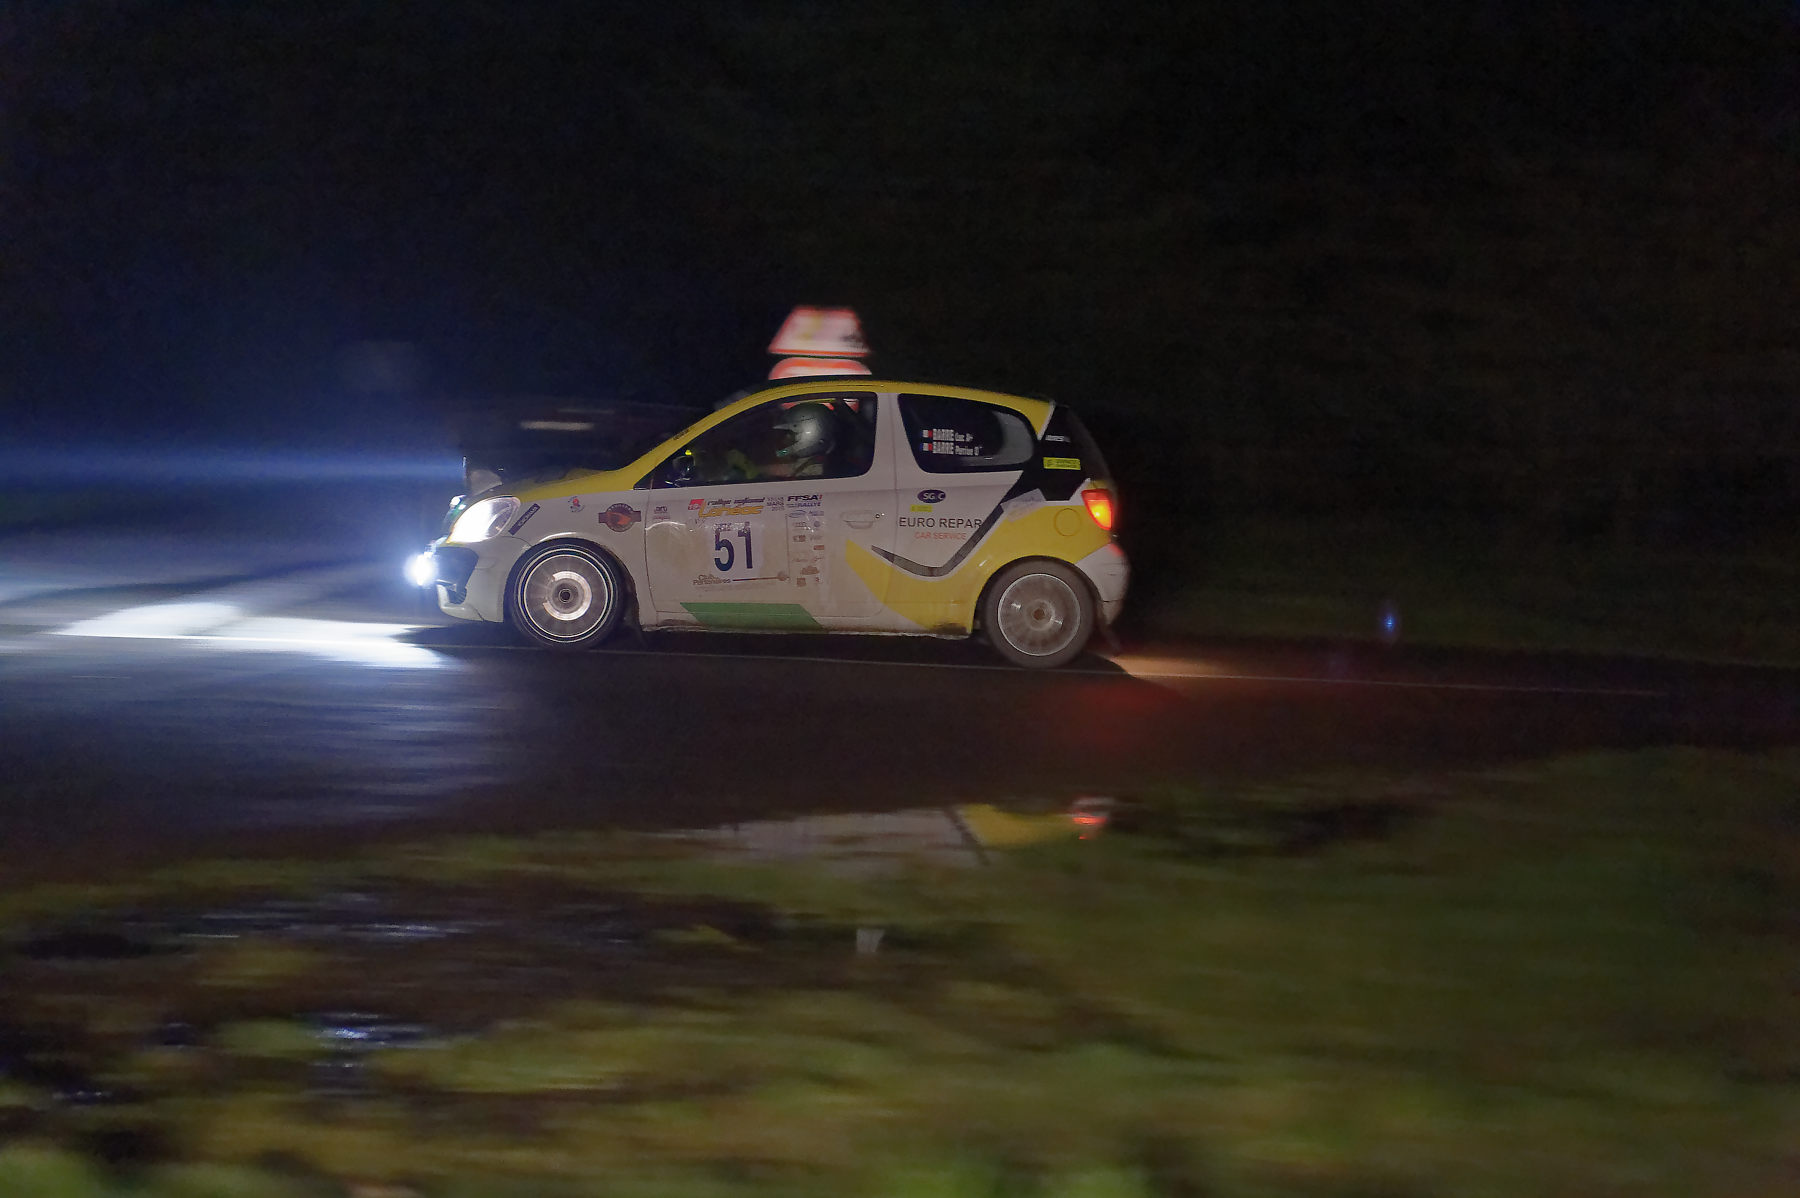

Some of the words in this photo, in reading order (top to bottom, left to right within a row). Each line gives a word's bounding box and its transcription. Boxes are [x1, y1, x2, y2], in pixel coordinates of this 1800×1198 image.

[899, 517, 935, 527] EURO
[939, 518, 982, 528] REPAR
[934, 532, 967, 540] SERVICE
[714, 521, 754, 571] 51
